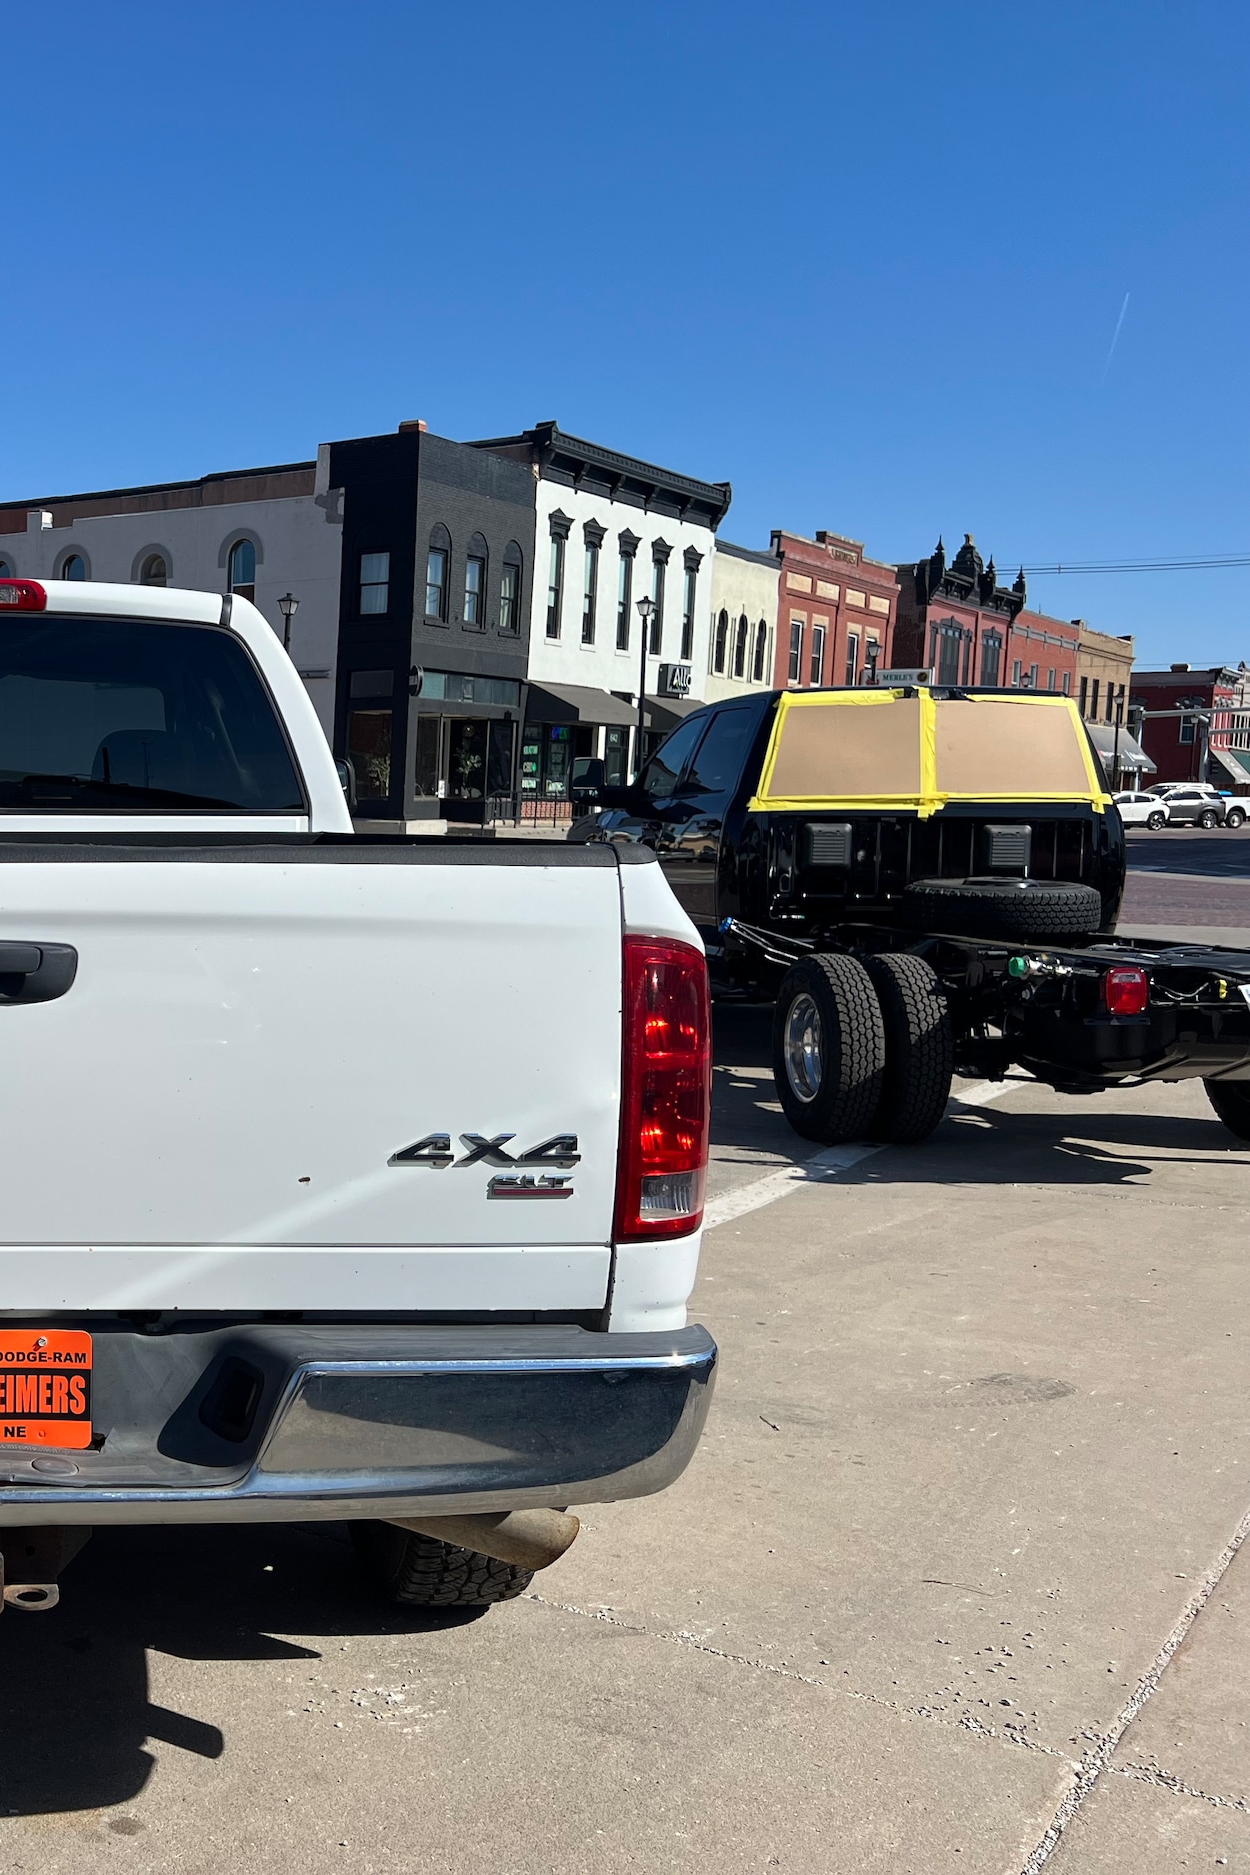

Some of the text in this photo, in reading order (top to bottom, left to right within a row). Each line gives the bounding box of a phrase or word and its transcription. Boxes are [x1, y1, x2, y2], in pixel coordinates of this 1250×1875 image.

[387, 1132, 582, 1169] 4X4
[489, 1173, 575, 1192] SLT
[3, 1426, 27, 1438] NE
